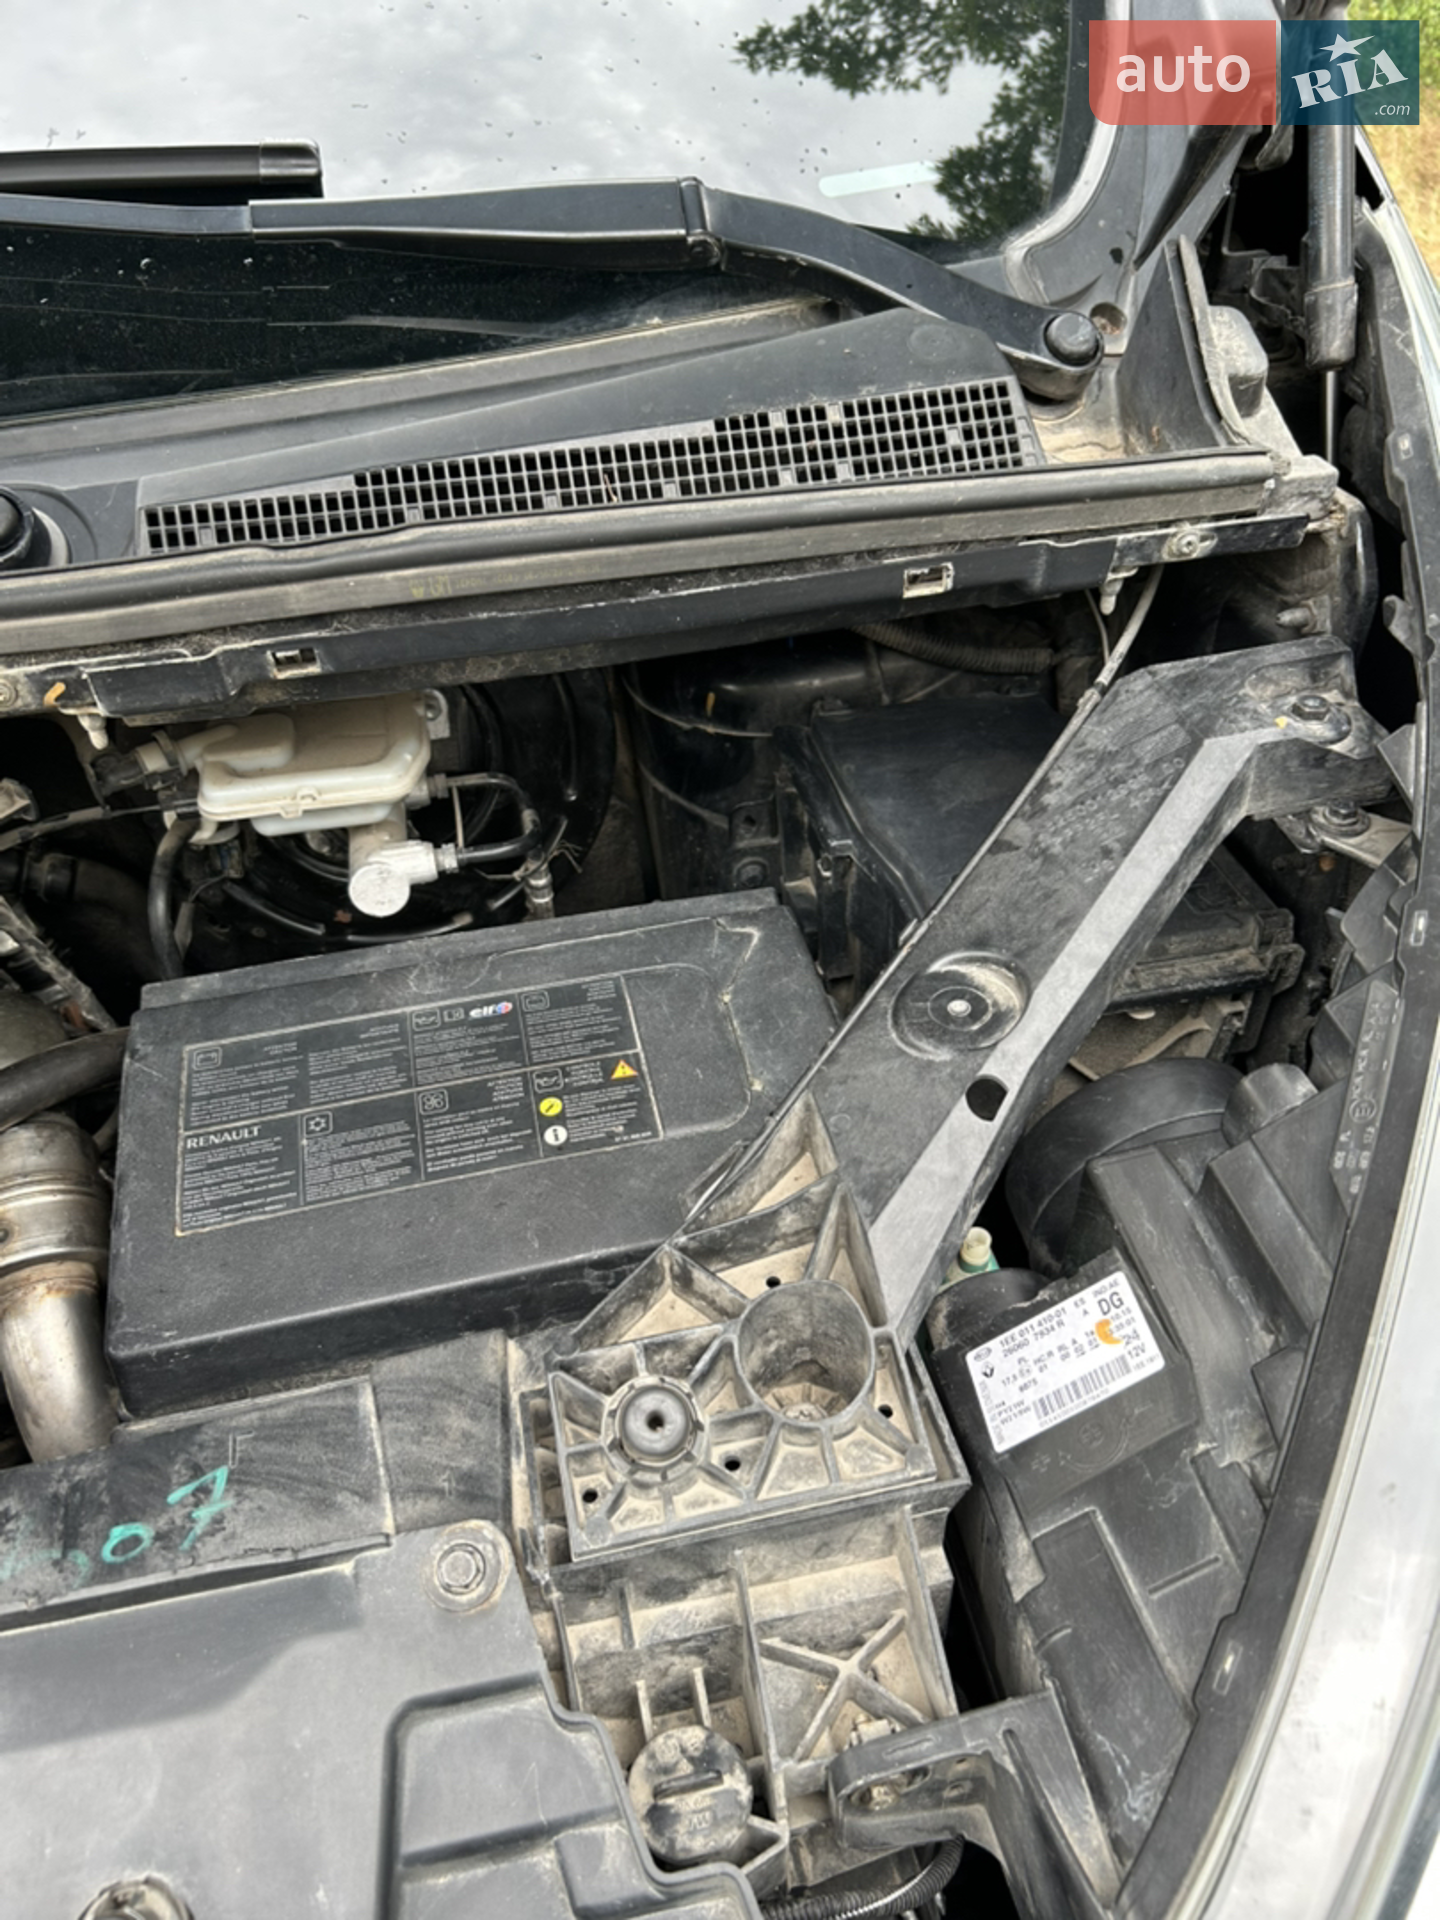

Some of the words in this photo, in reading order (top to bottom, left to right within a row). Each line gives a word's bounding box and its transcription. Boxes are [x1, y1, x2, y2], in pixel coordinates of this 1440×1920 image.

[186, 1125, 262, 1149] RENAULT
[1097, 1291, 1124, 1316] DG
[1127, 1342, 1146, 1359] 12V
